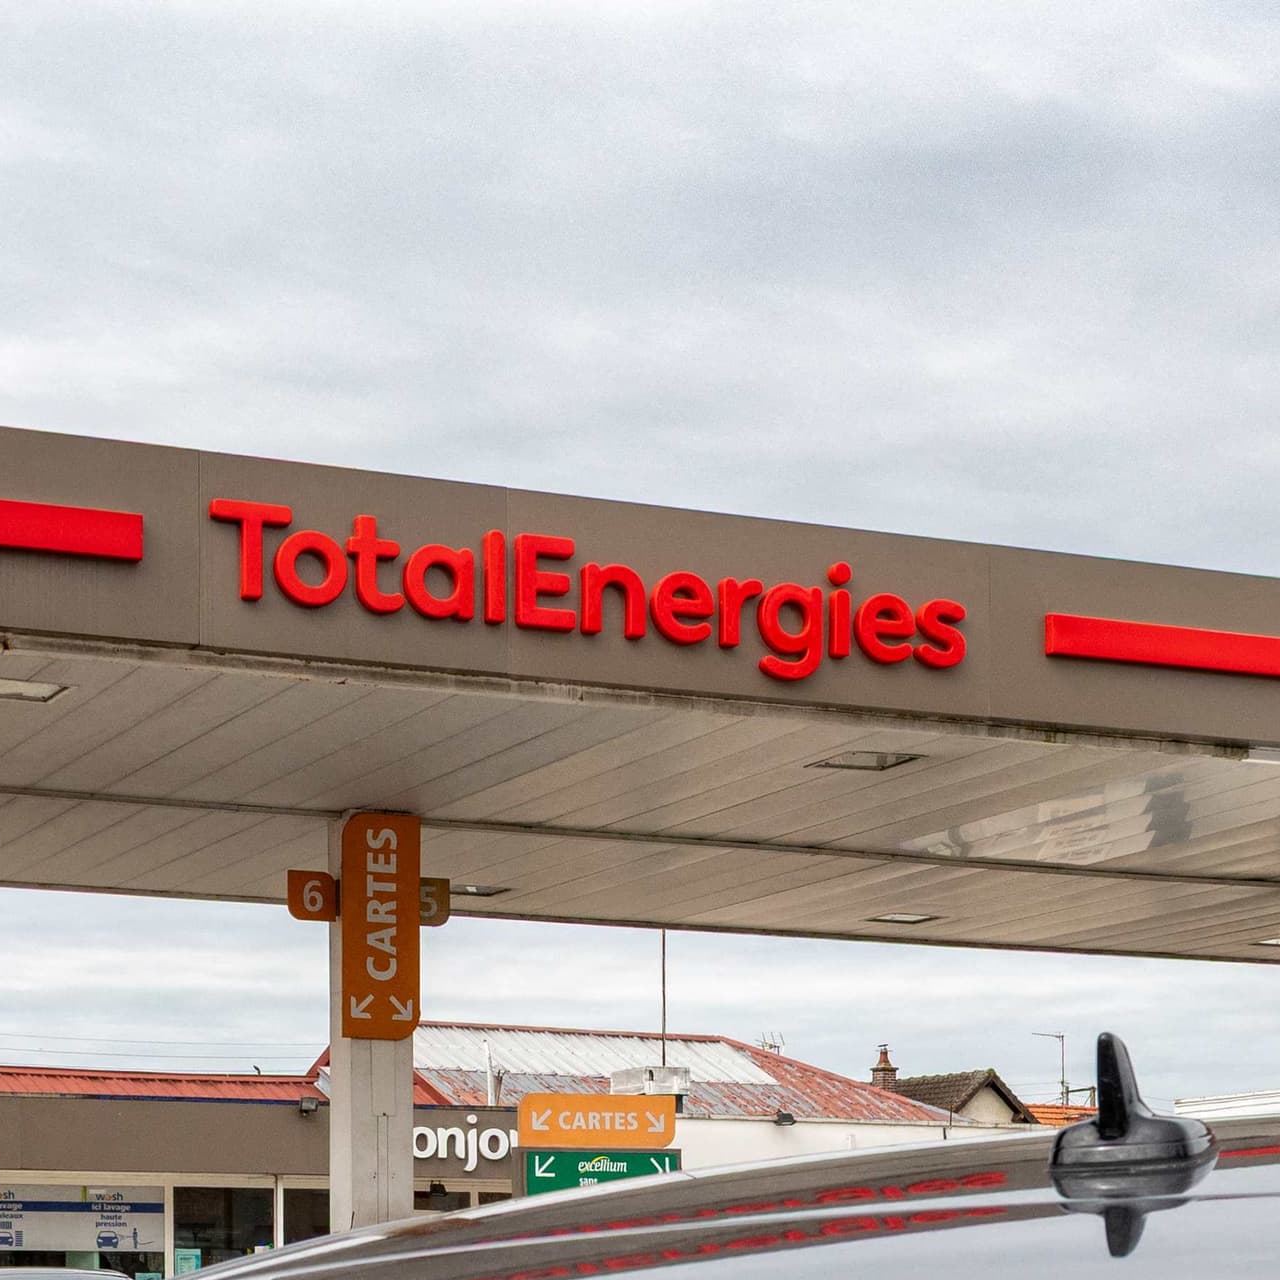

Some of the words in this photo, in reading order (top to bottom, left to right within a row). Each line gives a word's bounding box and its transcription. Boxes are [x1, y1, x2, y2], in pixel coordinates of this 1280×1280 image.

[208, 498, 968, 682] TotalEnergies
[303, 879, 324, 912] 6
[366, 828, 398, 981] CARTES
[557, 1111, 639, 1131] CARTES
[413, 1113, 518, 1172] onjo
[577, 1158, 627, 1174] excellium
[95, 1192, 123, 1201] wash
[104, 1203, 131, 1213] lavage
